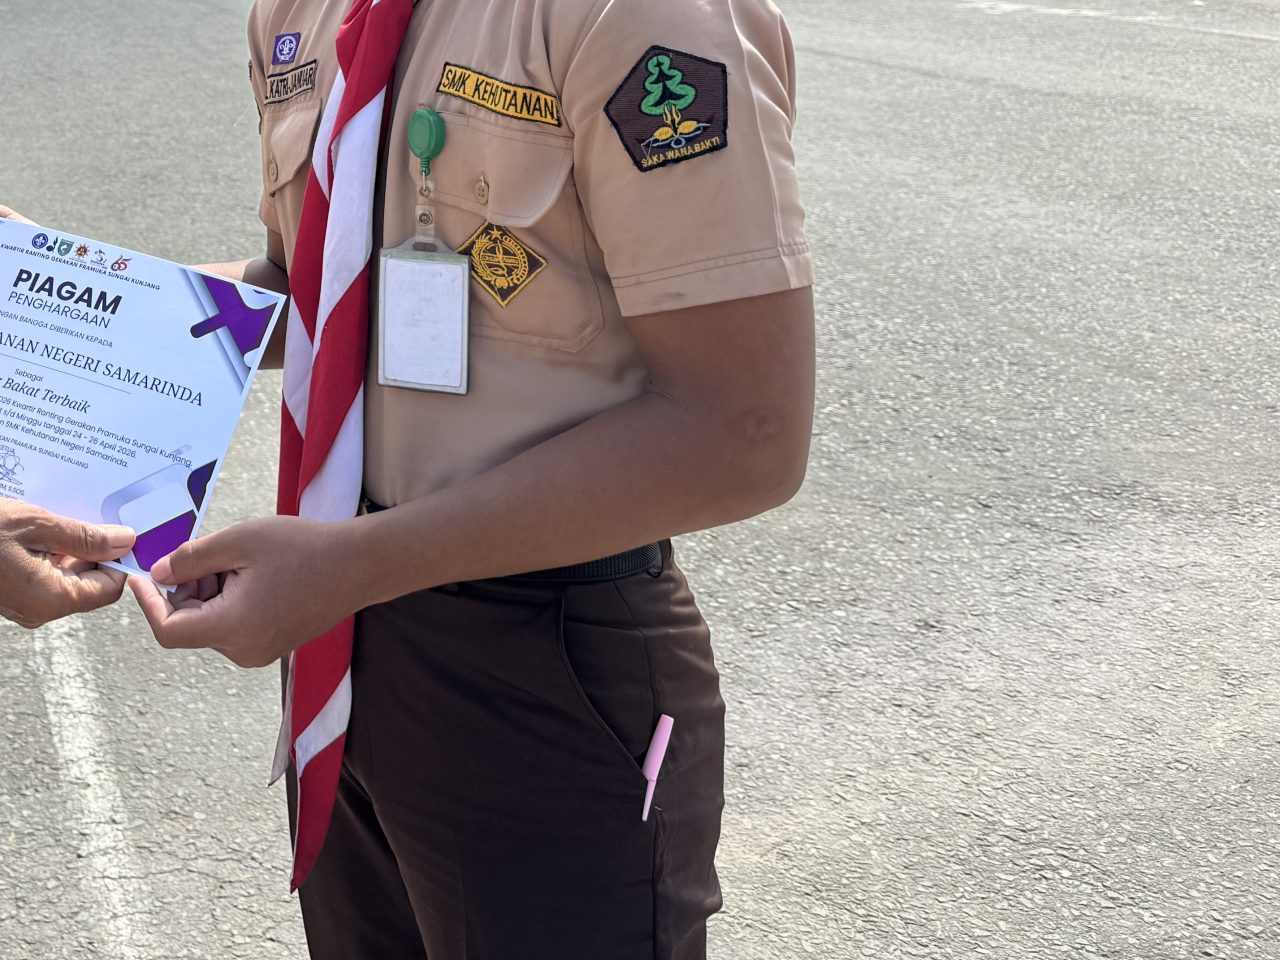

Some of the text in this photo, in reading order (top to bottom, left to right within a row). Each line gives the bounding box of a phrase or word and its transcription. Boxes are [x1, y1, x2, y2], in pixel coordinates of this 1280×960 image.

[443, 69, 554, 121] SMK KEHUTANAN
[641, 136, 720, 167] SAKA WANA BAKTI
[1, 244, 25, 253] KWARTIR
[25, 250, 50, 260] RANTING
[51, 256, 79, 267] GERAKAN
[78, 263, 106, 275] PRAMUKA
[108, 272, 131, 282] SUNGAI
[131, 278, 160, 290] KUNJANG
[8, 291, 111, 329] PENGHARGAAN
[13, 269, 122, 315] PIAGAM
[18, 315, 48, 329] BANGGA
[49, 324, 86, 340] DIBERIKAN
[85, 335, 112, 348] KEPADA
[2, 377, 41, 398] Bakat
[41, 389, 91, 414] Terbaik
[14, 368, 44, 382] Sebagai
[40, 344, 102, 373] NEGERI
[102, 363, 202, 406] SAMARINDA
[3, 409, 16, 418] s/d
[16, 412, 43, 427] Minggu
[43, 421, 73, 436] tanggal
[72, 431, 83, 439] 24
[88, 436, 99, 445] 26
[99, 440, 118, 452] April
[116, 446, 136, 459] 2026.
[5, 420, 21, 431] SMK
[21, 425, 60, 444] Kehutanan
[60, 438, 85, 452] Negeri
[85, 447, 128, 468] Samarinda.
[11, 400, 36, 413] Kwartir
[36, 408, 64, 424] Ranting
[65, 417, 96, 432] Gerakan
[97, 427, 131, 445] Pramuka
[131, 439, 159, 454] Sungai
[159, 449, 192, 468] Kunjang.
